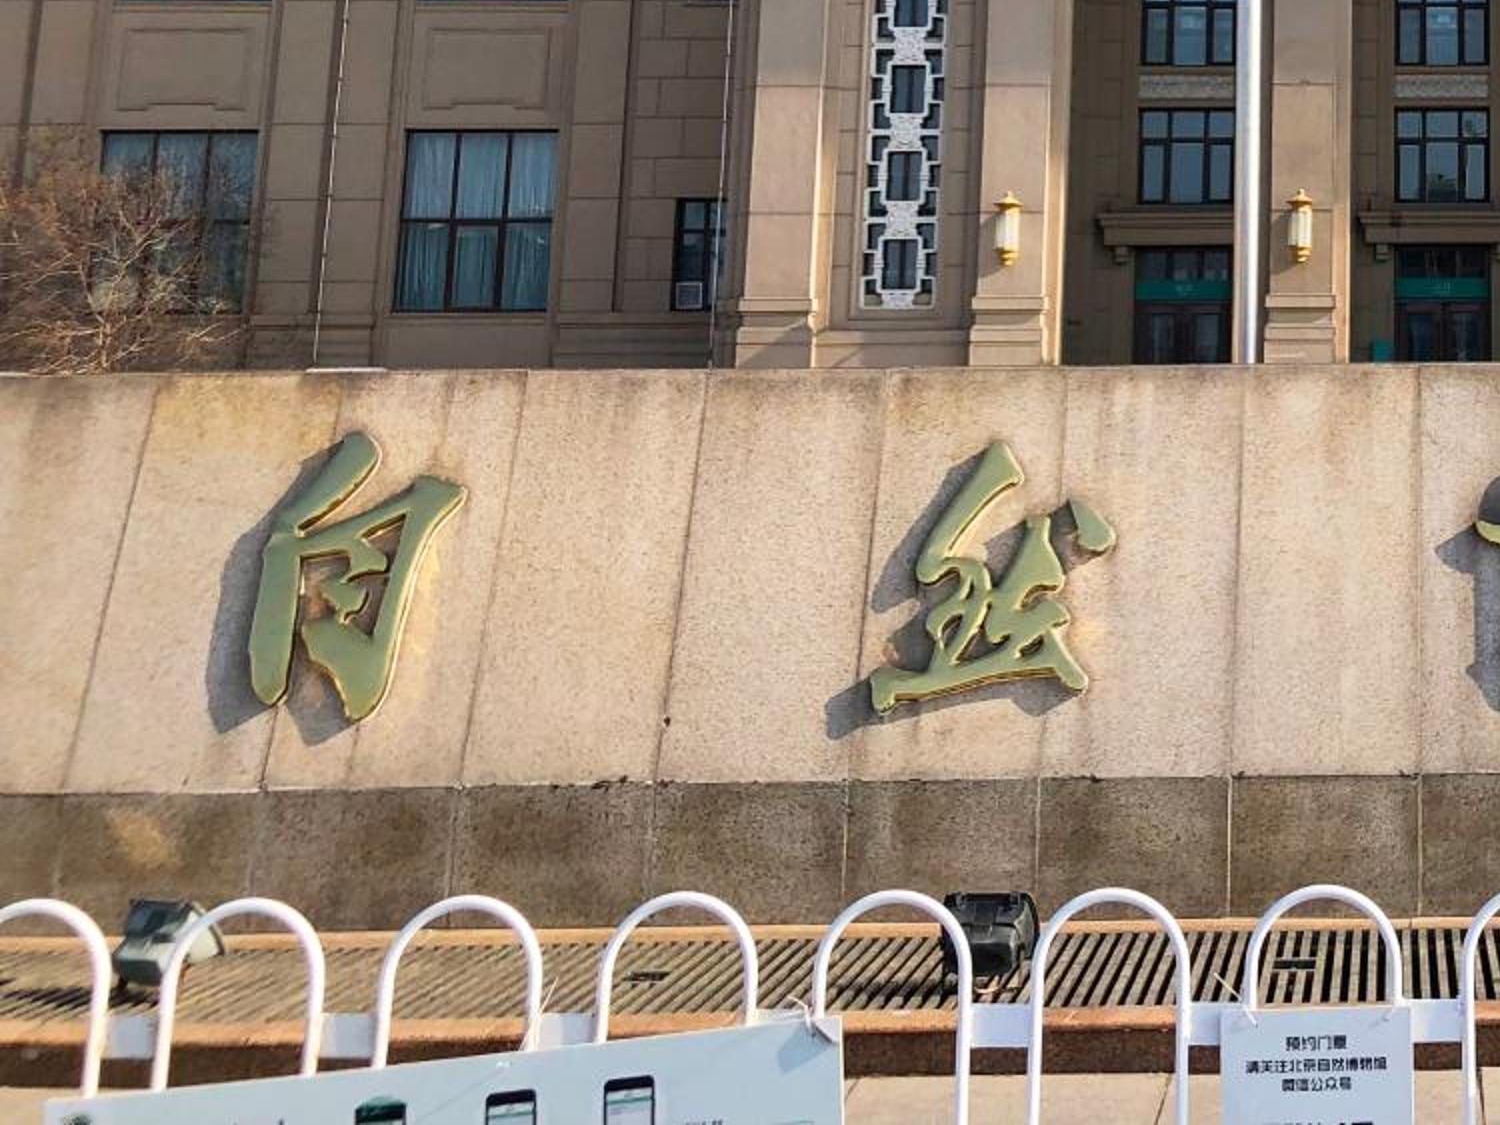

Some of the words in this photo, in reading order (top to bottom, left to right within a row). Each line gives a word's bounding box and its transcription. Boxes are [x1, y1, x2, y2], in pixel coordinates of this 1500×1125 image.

[1285, 1034, 1347, 1051] 预约门票
[1245, 1056, 1388, 1074] 请关注北京自然博物馆
[1281, 1076, 1352, 1092] 微信公众号
